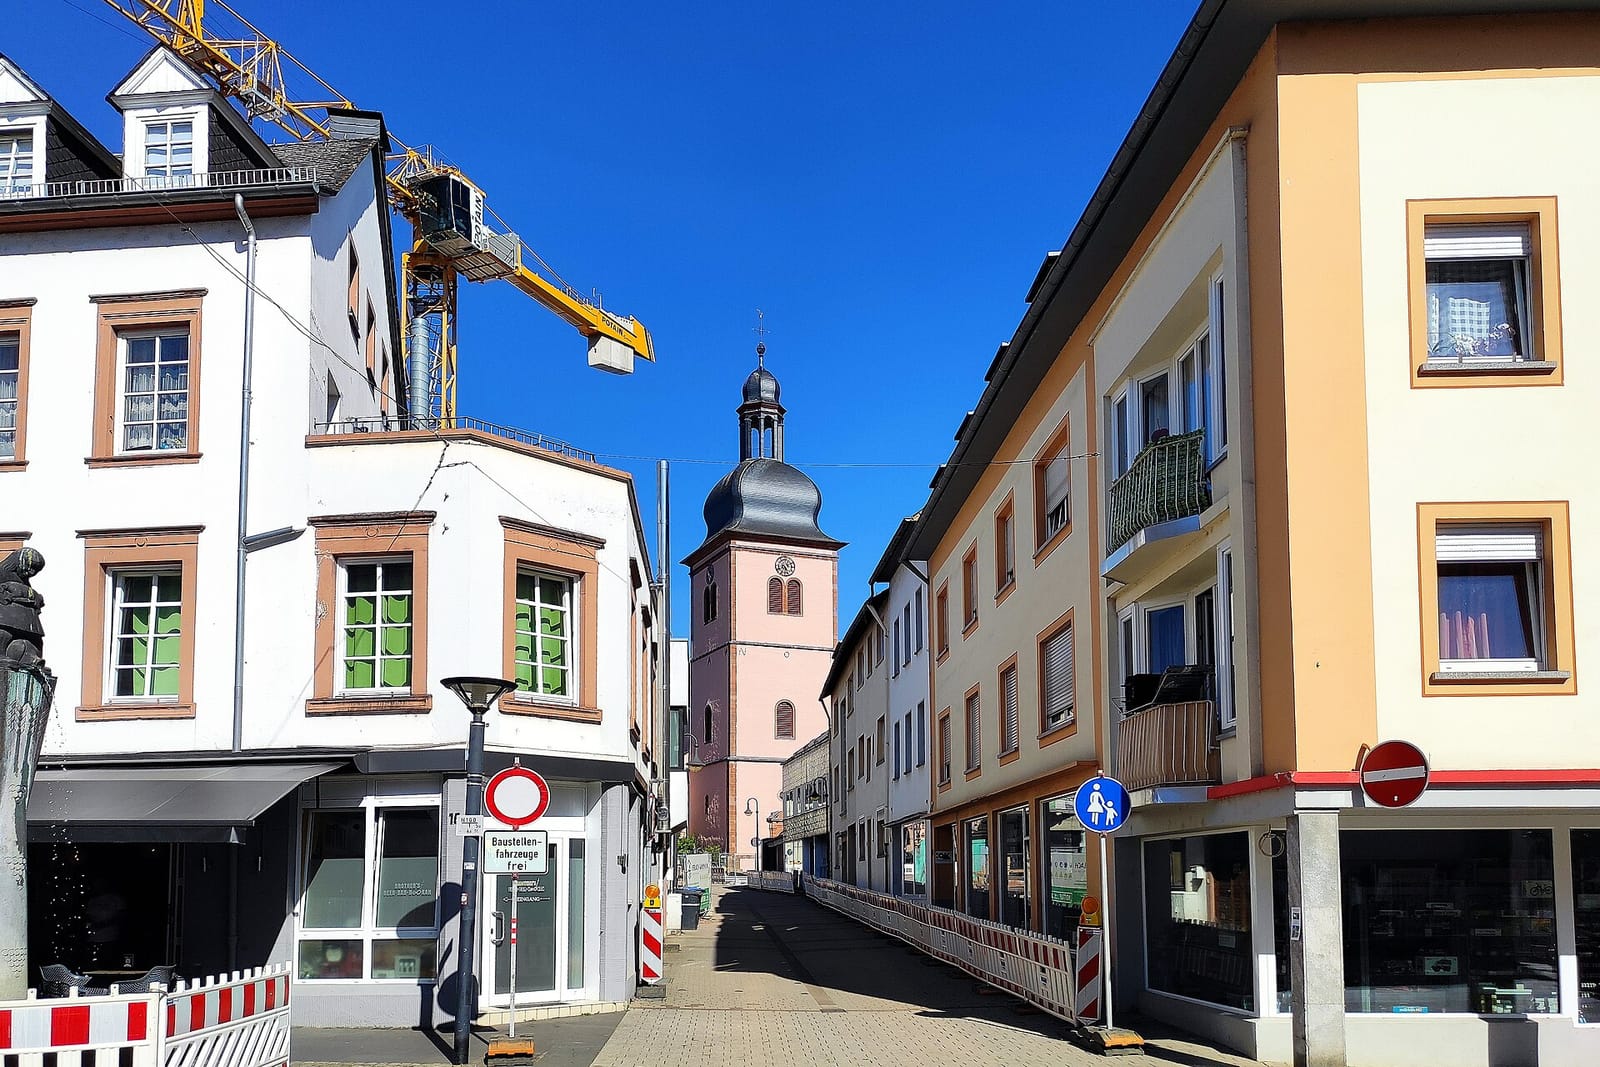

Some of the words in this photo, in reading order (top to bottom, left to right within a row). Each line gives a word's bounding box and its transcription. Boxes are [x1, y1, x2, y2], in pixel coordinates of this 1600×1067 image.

[474, 195, 482, 248] POTAIN
[601, 316, 623, 336] POTAIN
[492, 837, 542, 846] Baustellen-
[496, 849, 538, 860] fahrzeuge
[507, 861, 527, 870] frei
